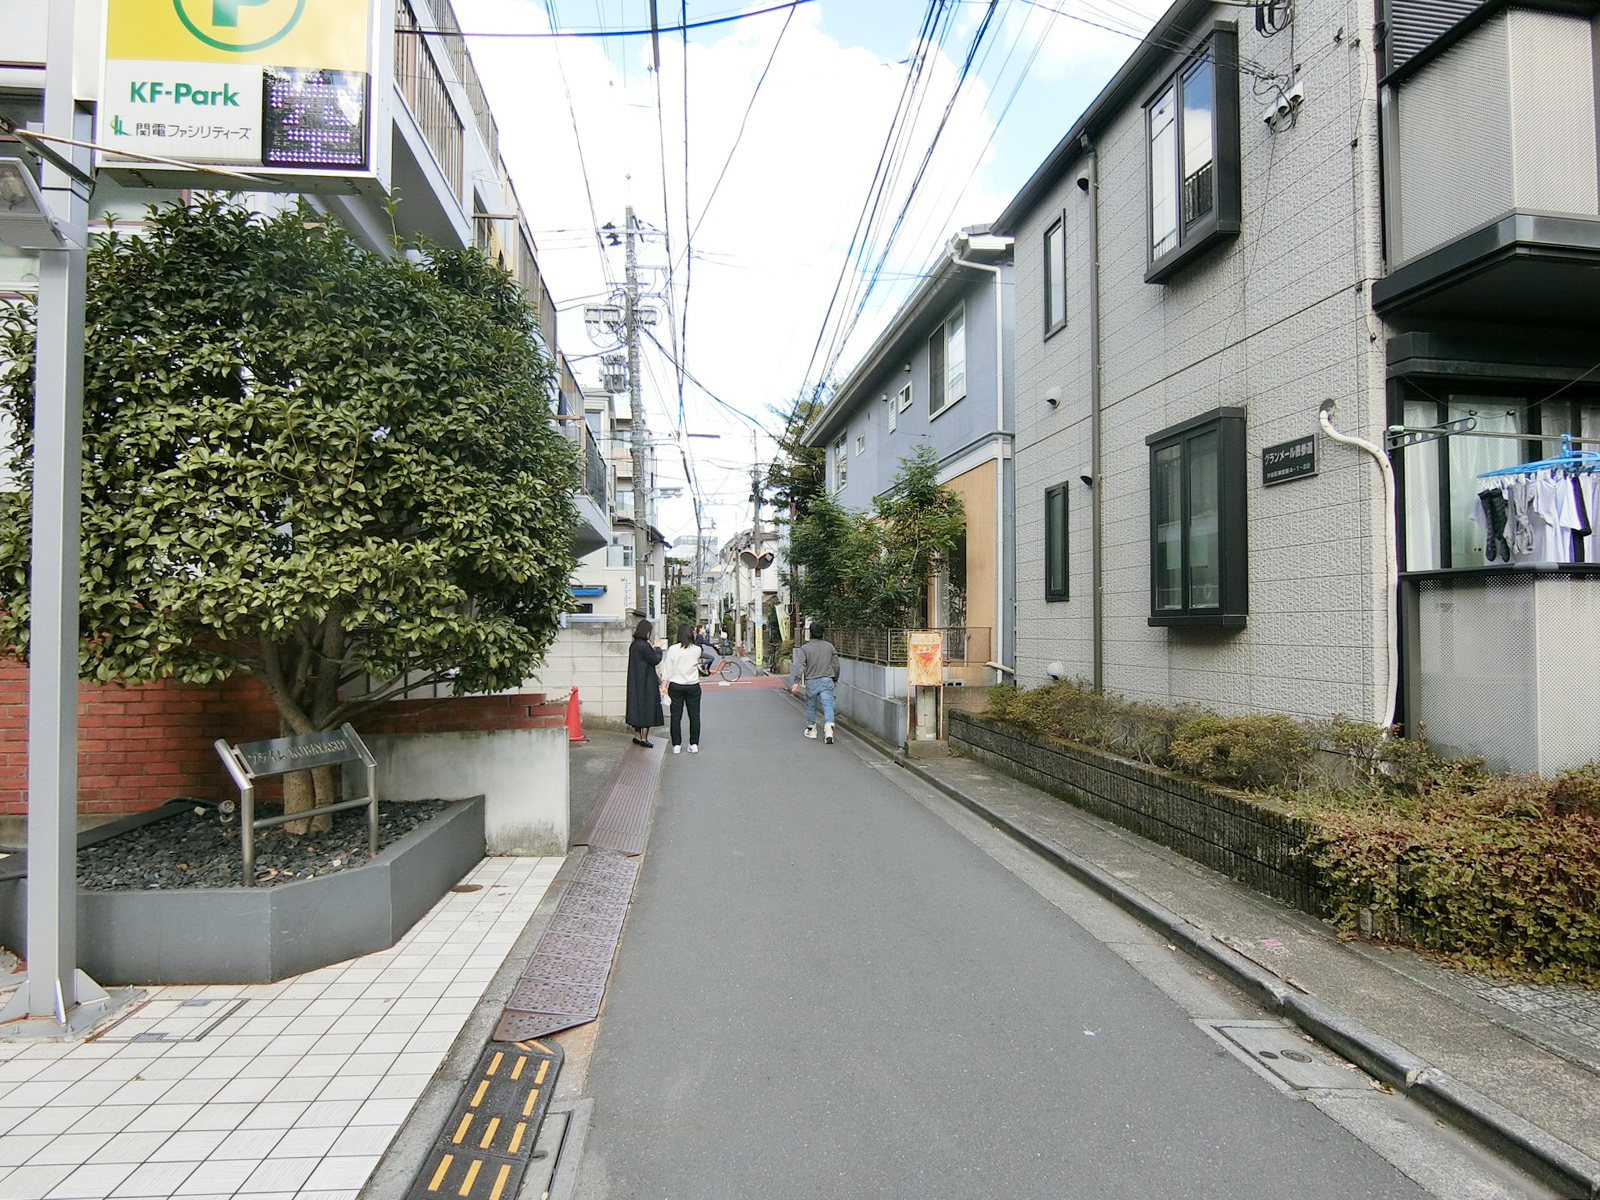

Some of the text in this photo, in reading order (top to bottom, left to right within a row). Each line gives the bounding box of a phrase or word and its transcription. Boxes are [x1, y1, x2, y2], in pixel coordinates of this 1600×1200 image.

[130, 81, 240, 107] KF-Park
[136, 122, 252, 140] 関電ファシリティーズ
